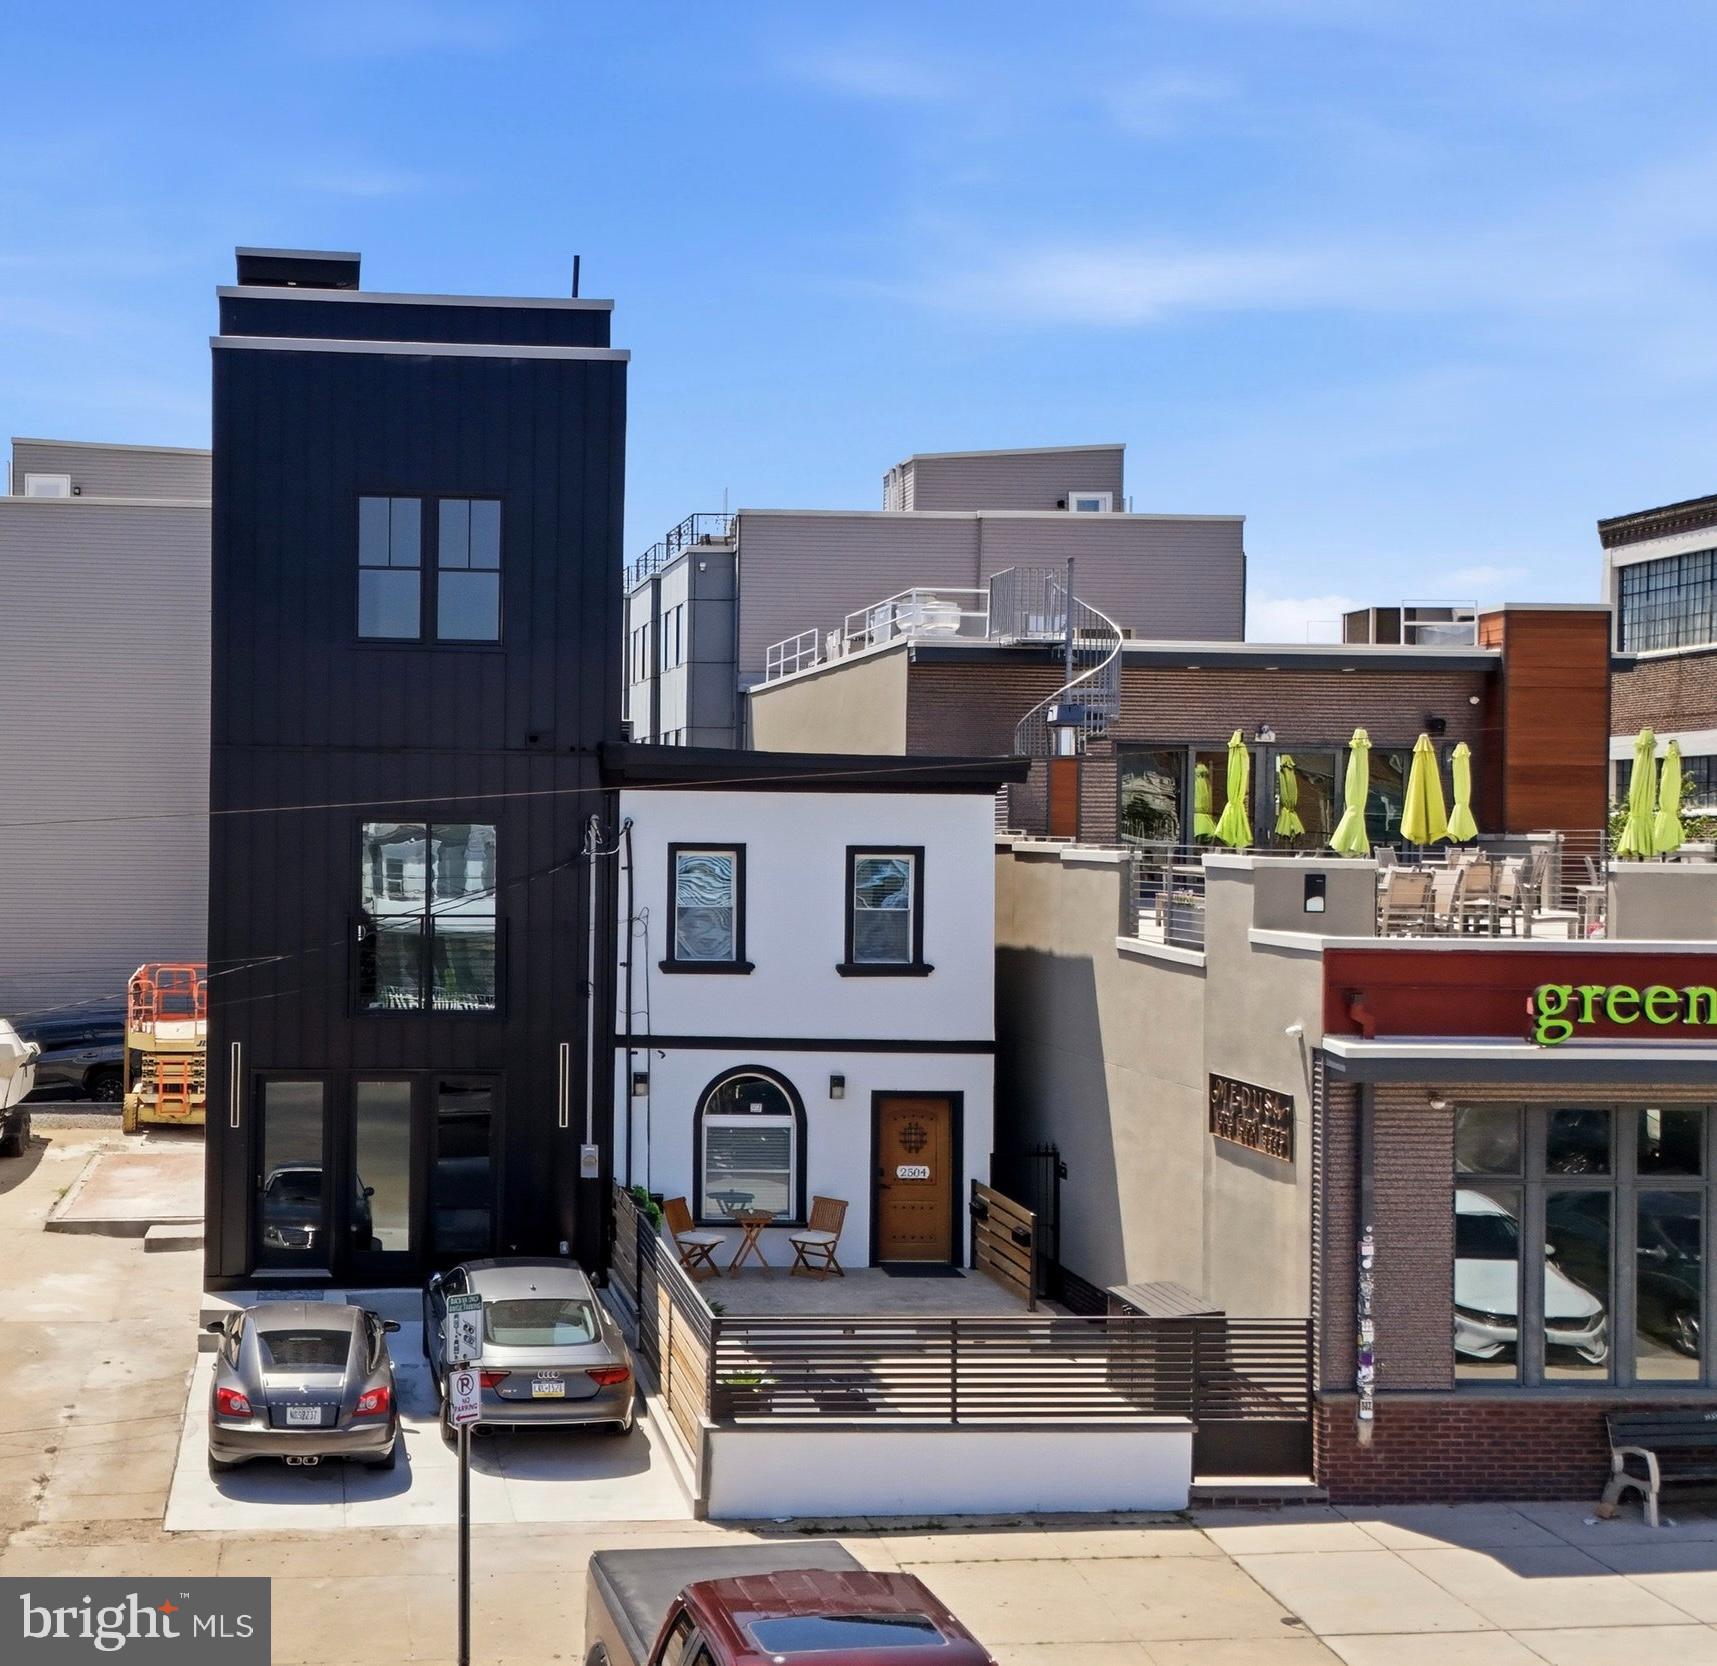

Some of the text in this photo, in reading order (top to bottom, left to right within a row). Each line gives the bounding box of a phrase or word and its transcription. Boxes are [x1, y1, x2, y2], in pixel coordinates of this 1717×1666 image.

[1534, 983, 1717, 1046] green
[900, 1168, 926, 1177] 2504
[454, 1403, 478, 1412] PARKING
